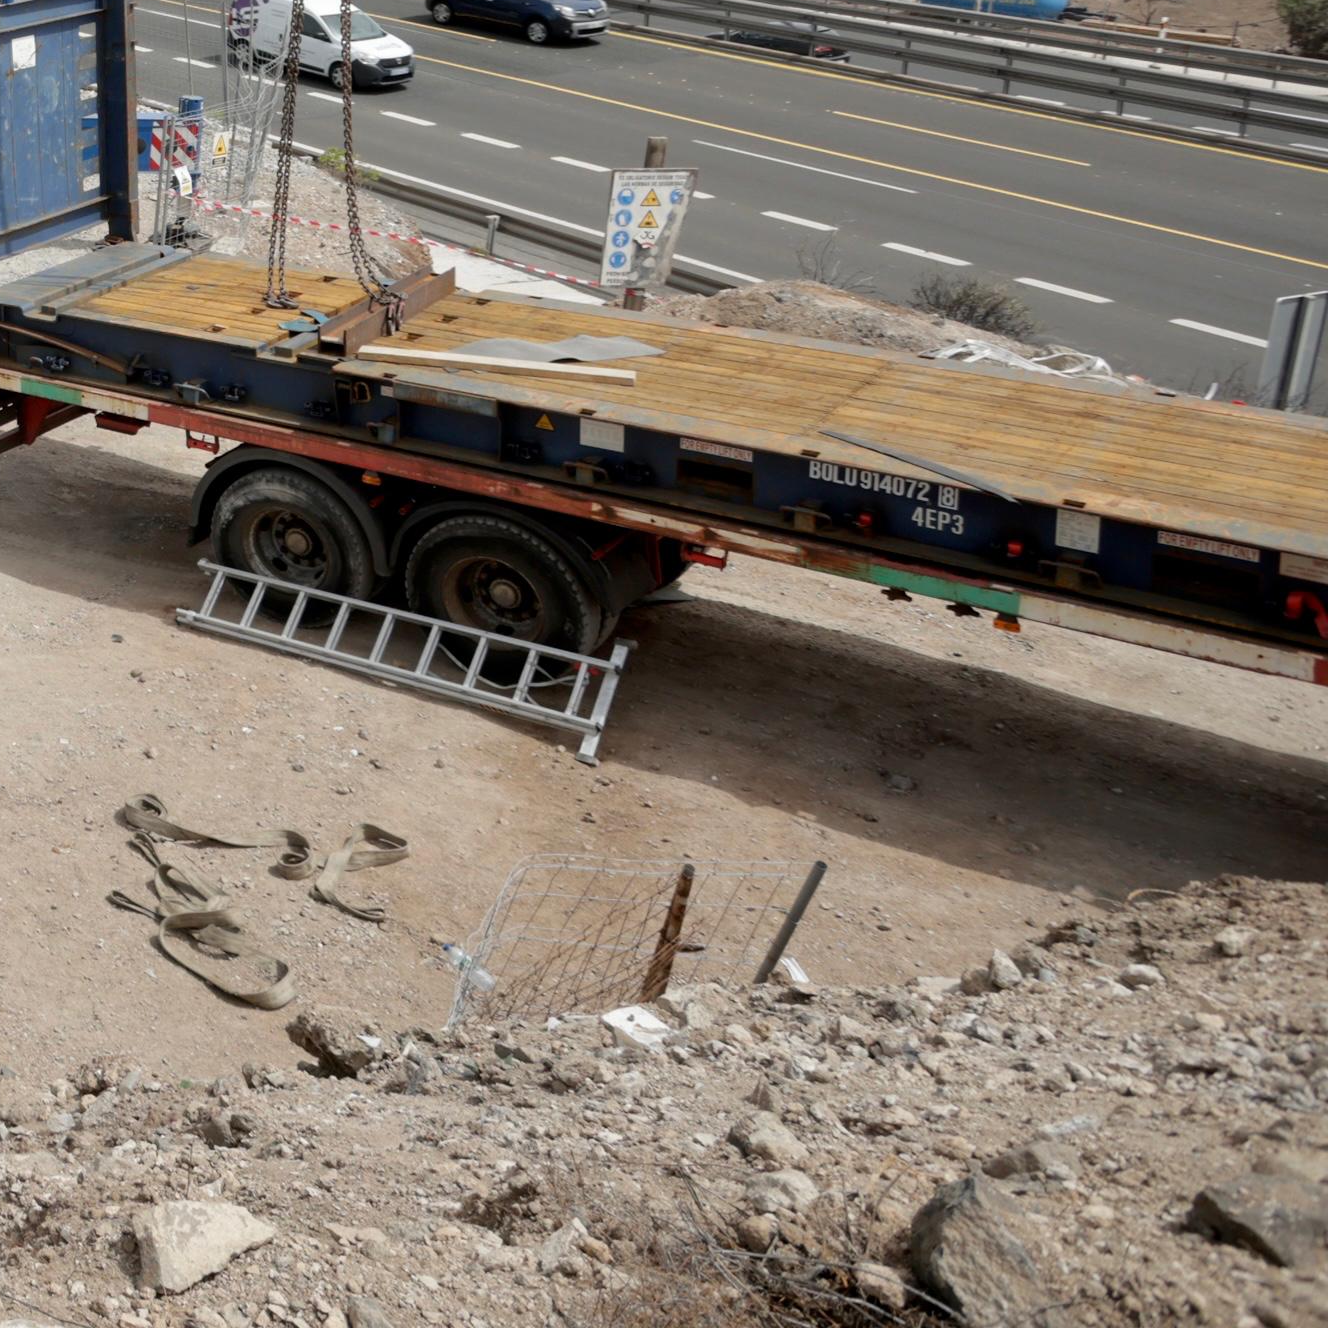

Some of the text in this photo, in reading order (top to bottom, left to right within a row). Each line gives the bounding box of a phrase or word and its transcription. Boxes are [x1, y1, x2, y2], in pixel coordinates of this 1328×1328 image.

[808, 460, 857, 487] BOLU
[859, 471, 931, 502] 914072
[911, 506, 964, 535] 4EP3
[1158, 531, 1258, 561] FOR EMPTY LIFT ONLY
